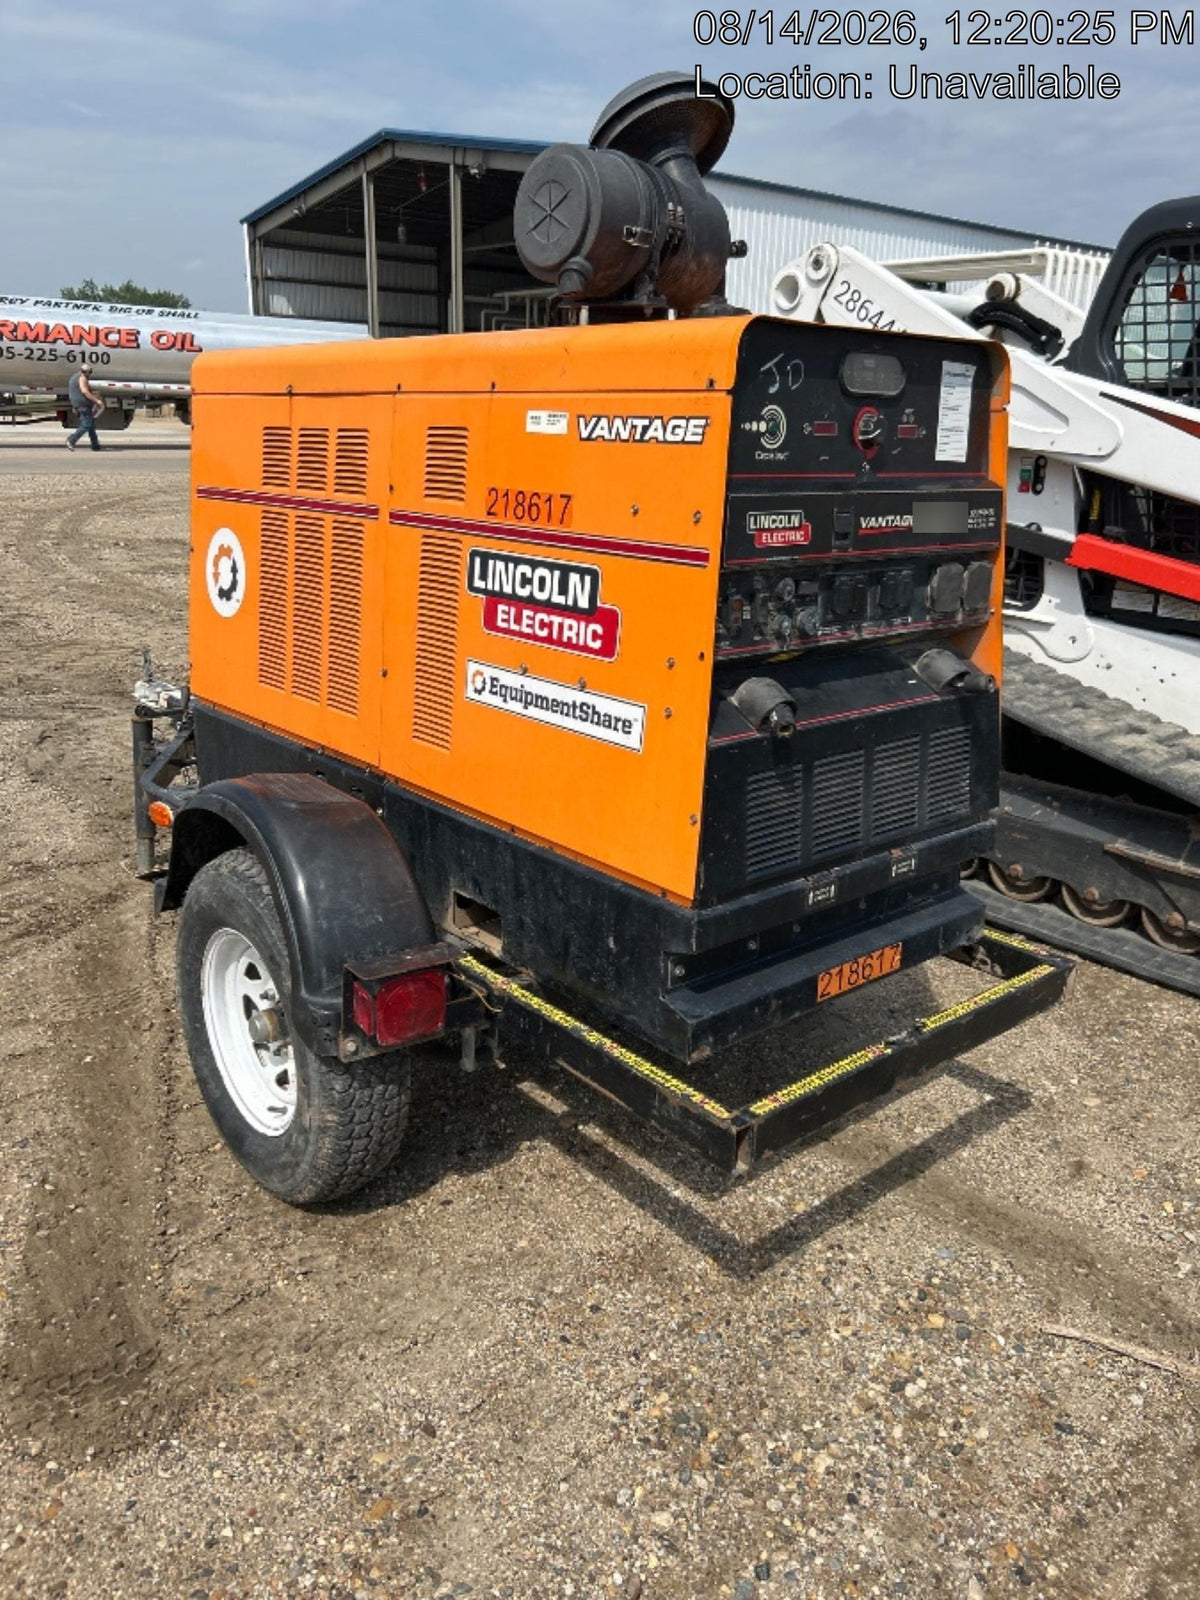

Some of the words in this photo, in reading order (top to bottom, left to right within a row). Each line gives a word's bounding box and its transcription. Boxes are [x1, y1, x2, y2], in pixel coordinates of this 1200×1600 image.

[833, 280, 907, 333] 28644
[0, 319, 140, 349] RMANCE
[150, 330, 203, 352] OIL
[577, 416, 707, 444] VANTAGE
[486, 487, 572, 525] 218617
[750, 513, 800, 529] LINCOLN
[860, 515, 913, 529] VANTAG
[762, 530, 804, 543] ELECTRIC
[473, 556, 592, 609] LINCOLN
[496, 604, 604, 649] ELECTRIC
[488, 675, 633, 735] EquipmentShare
[820, 943, 902, 998] 218617
